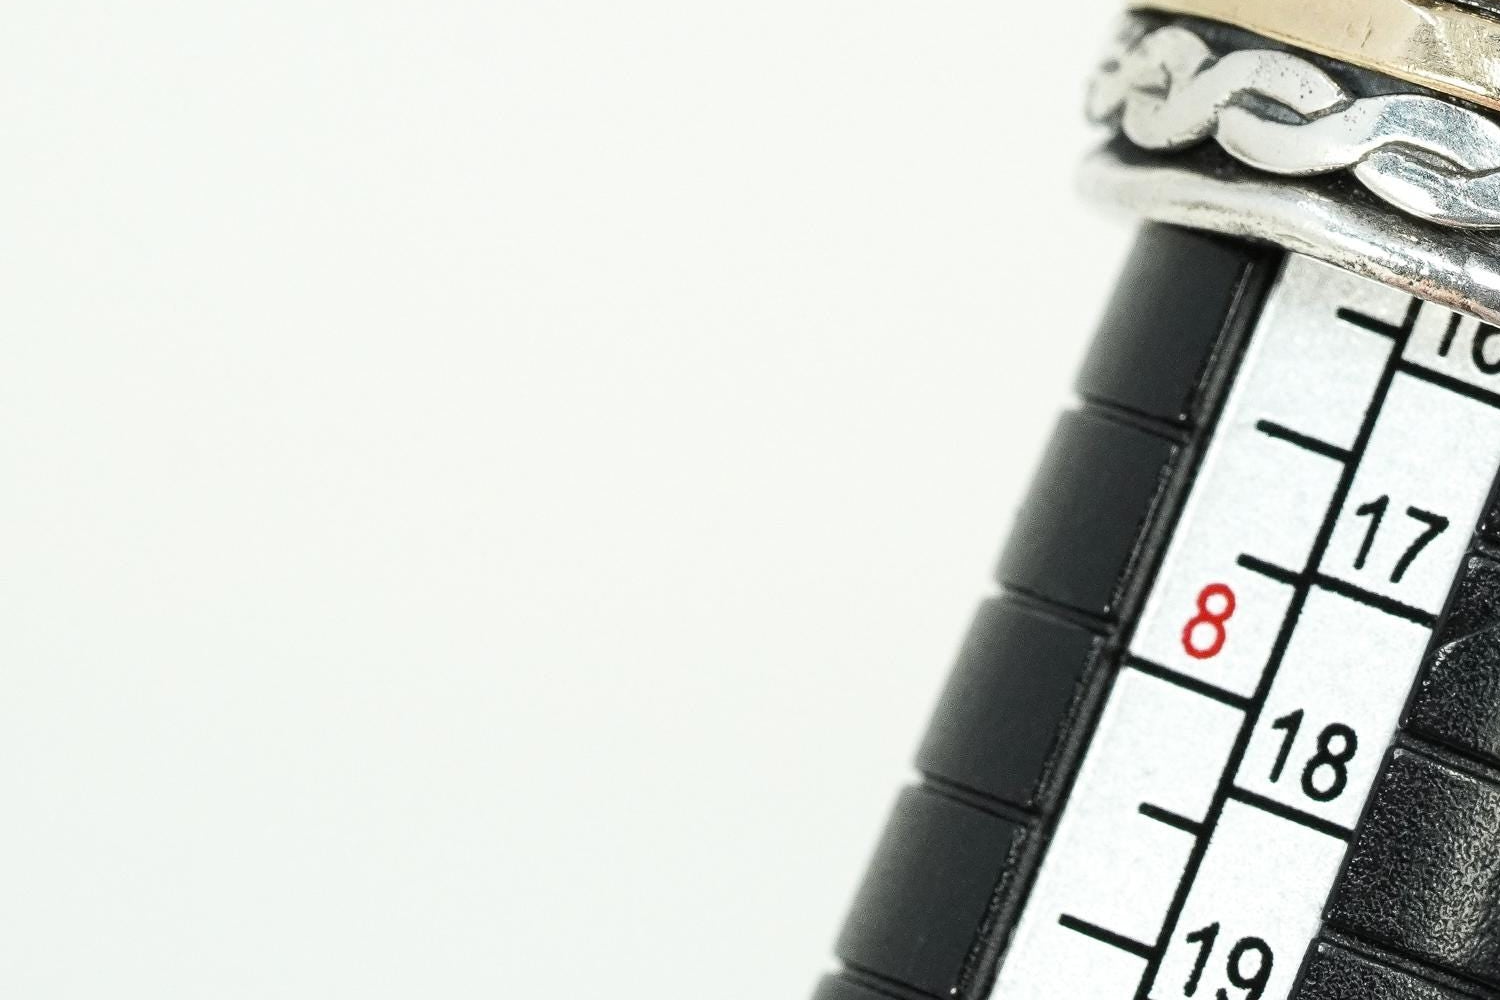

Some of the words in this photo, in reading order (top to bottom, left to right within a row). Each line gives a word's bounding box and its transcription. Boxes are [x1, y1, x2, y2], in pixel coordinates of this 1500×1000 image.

[1353, 493, 1451, 585] 17
[1181, 582, 1237, 660] 8
[1269, 708, 1359, 803] 18
[1182, 921, 1274, 1000] 19
